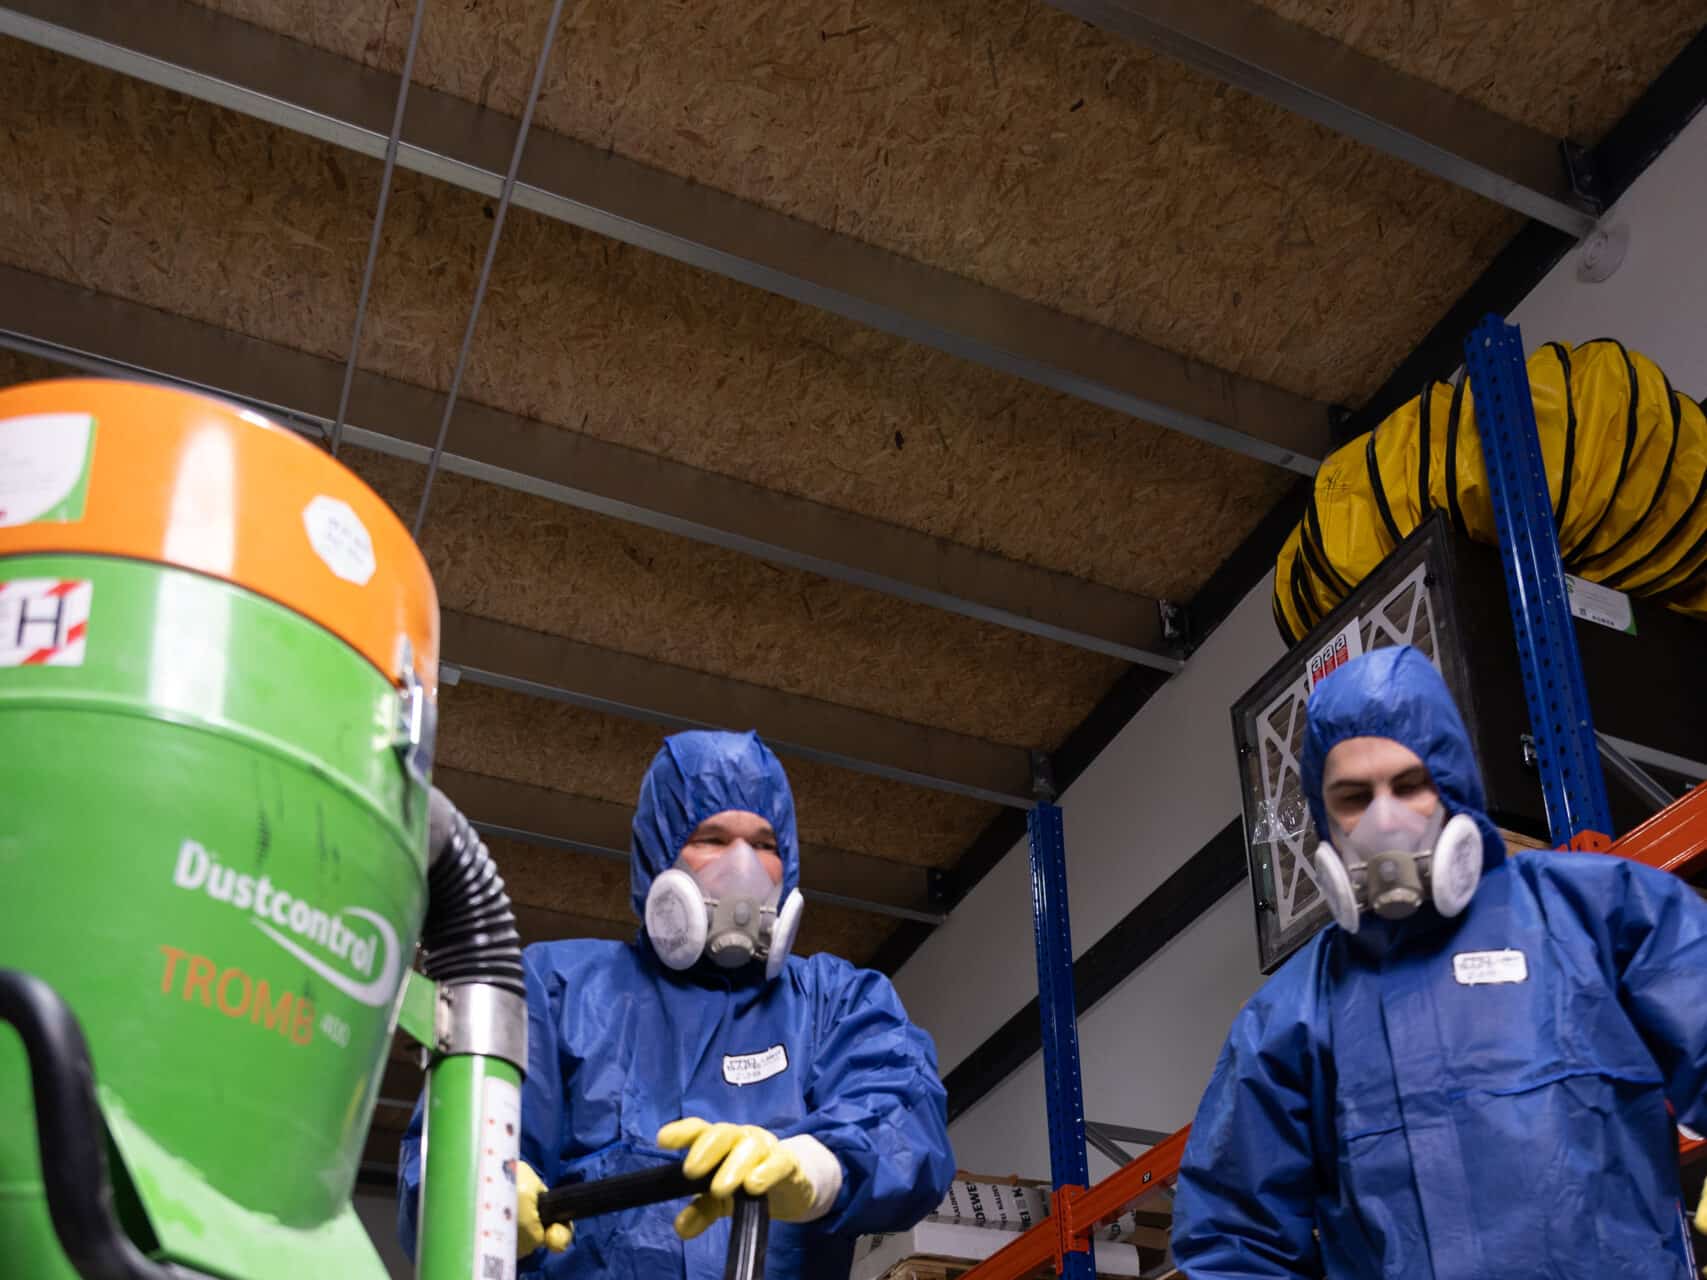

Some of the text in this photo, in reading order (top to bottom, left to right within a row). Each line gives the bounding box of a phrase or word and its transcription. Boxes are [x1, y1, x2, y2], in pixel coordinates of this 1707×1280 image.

[16, 597, 64, 648] H
[173, 838, 378, 977] Dustcontrol
[160, 946, 316, 1046] TROMB
